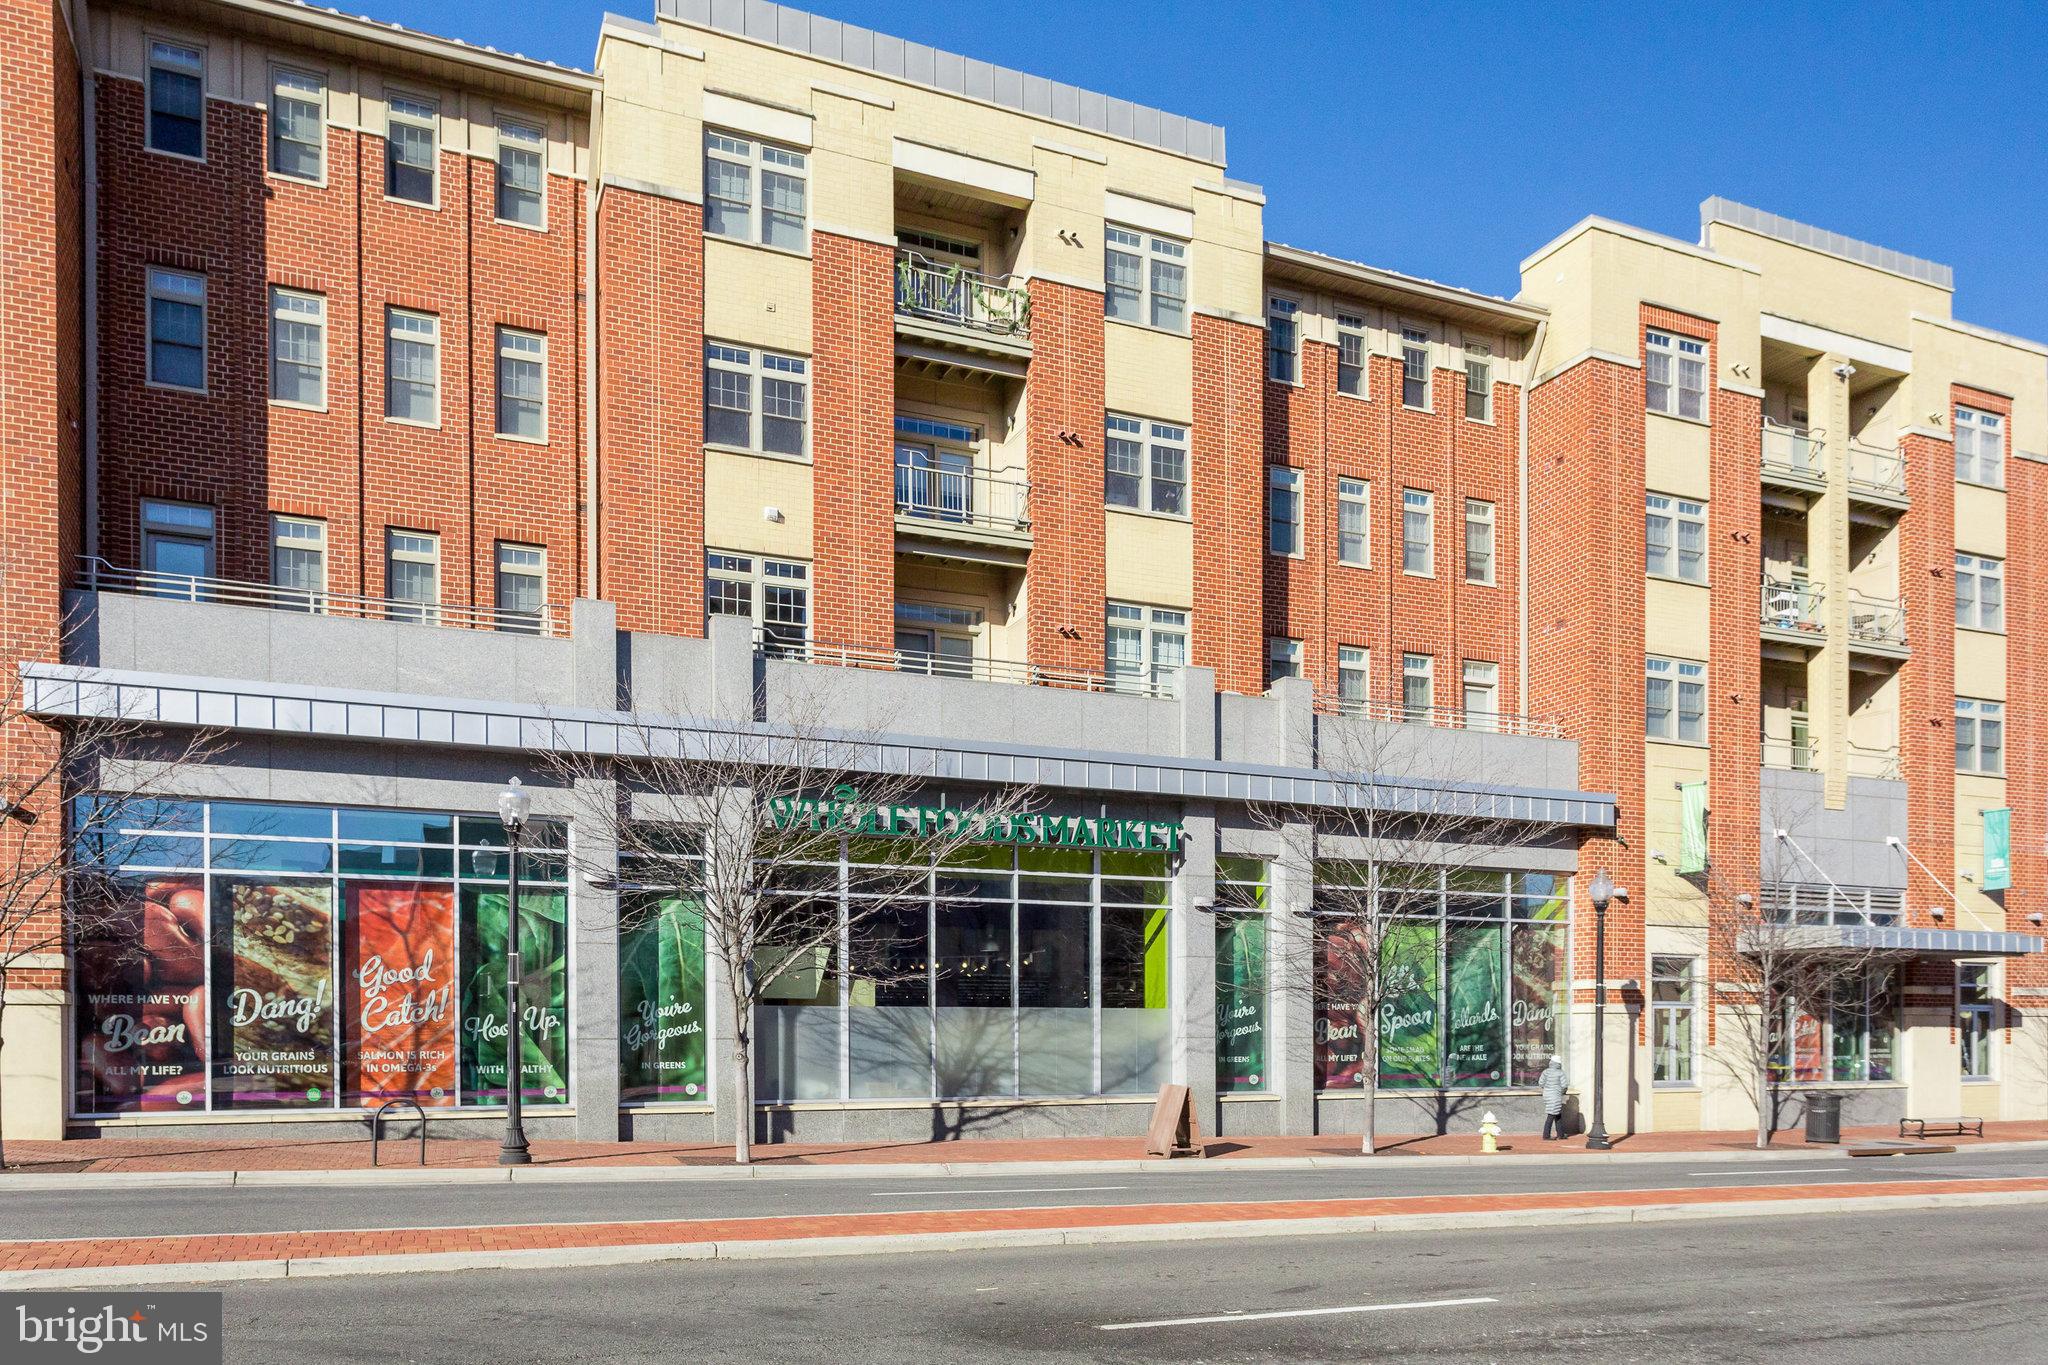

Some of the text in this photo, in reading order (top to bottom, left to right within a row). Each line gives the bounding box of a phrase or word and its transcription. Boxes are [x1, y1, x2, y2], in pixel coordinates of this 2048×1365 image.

[769, 794, 1184, 851] WHOLE FOODS MARKET
[352, 948, 436, 998] Good
[88, 994, 199, 1005] WHERE HAVE YOU
[226, 978, 327, 1034] Dang!
[360, 985, 450, 1033] Catch!
[1331, 1003, 1350, 1011] HAVE
[637, 994, 692, 1027] You're
[1216, 999, 1257, 1027] You're
[101, 1013, 186, 1053] Bean
[523, 1006, 560, 1041] Up
[1314, 1017, 1358, 1045] Bean
[1380, 1003, 1432, 1044] Spoon
[623, 1020, 703, 1051] Gorgeous
[235, 1051, 315, 1061] YOUR GRAINS
[357, 1051, 445, 1060] SALMON IS RICH
[1328, 1054, 1340, 1062] MY
[1341, 1054, 1358, 1062] LIFE?
[1471, 1053, 1488, 1061] KALE
[105, 1065, 184, 1075] ALL MY LIFE?
[223, 1064, 328, 1075] LOOK NUTRITIOUS
[366, 1063, 437, 1073] IN OMEGA-3s
[476, 1064, 554, 1074] WITH ALTHY
[641, 1061, 686, 1070] IN GREENS
